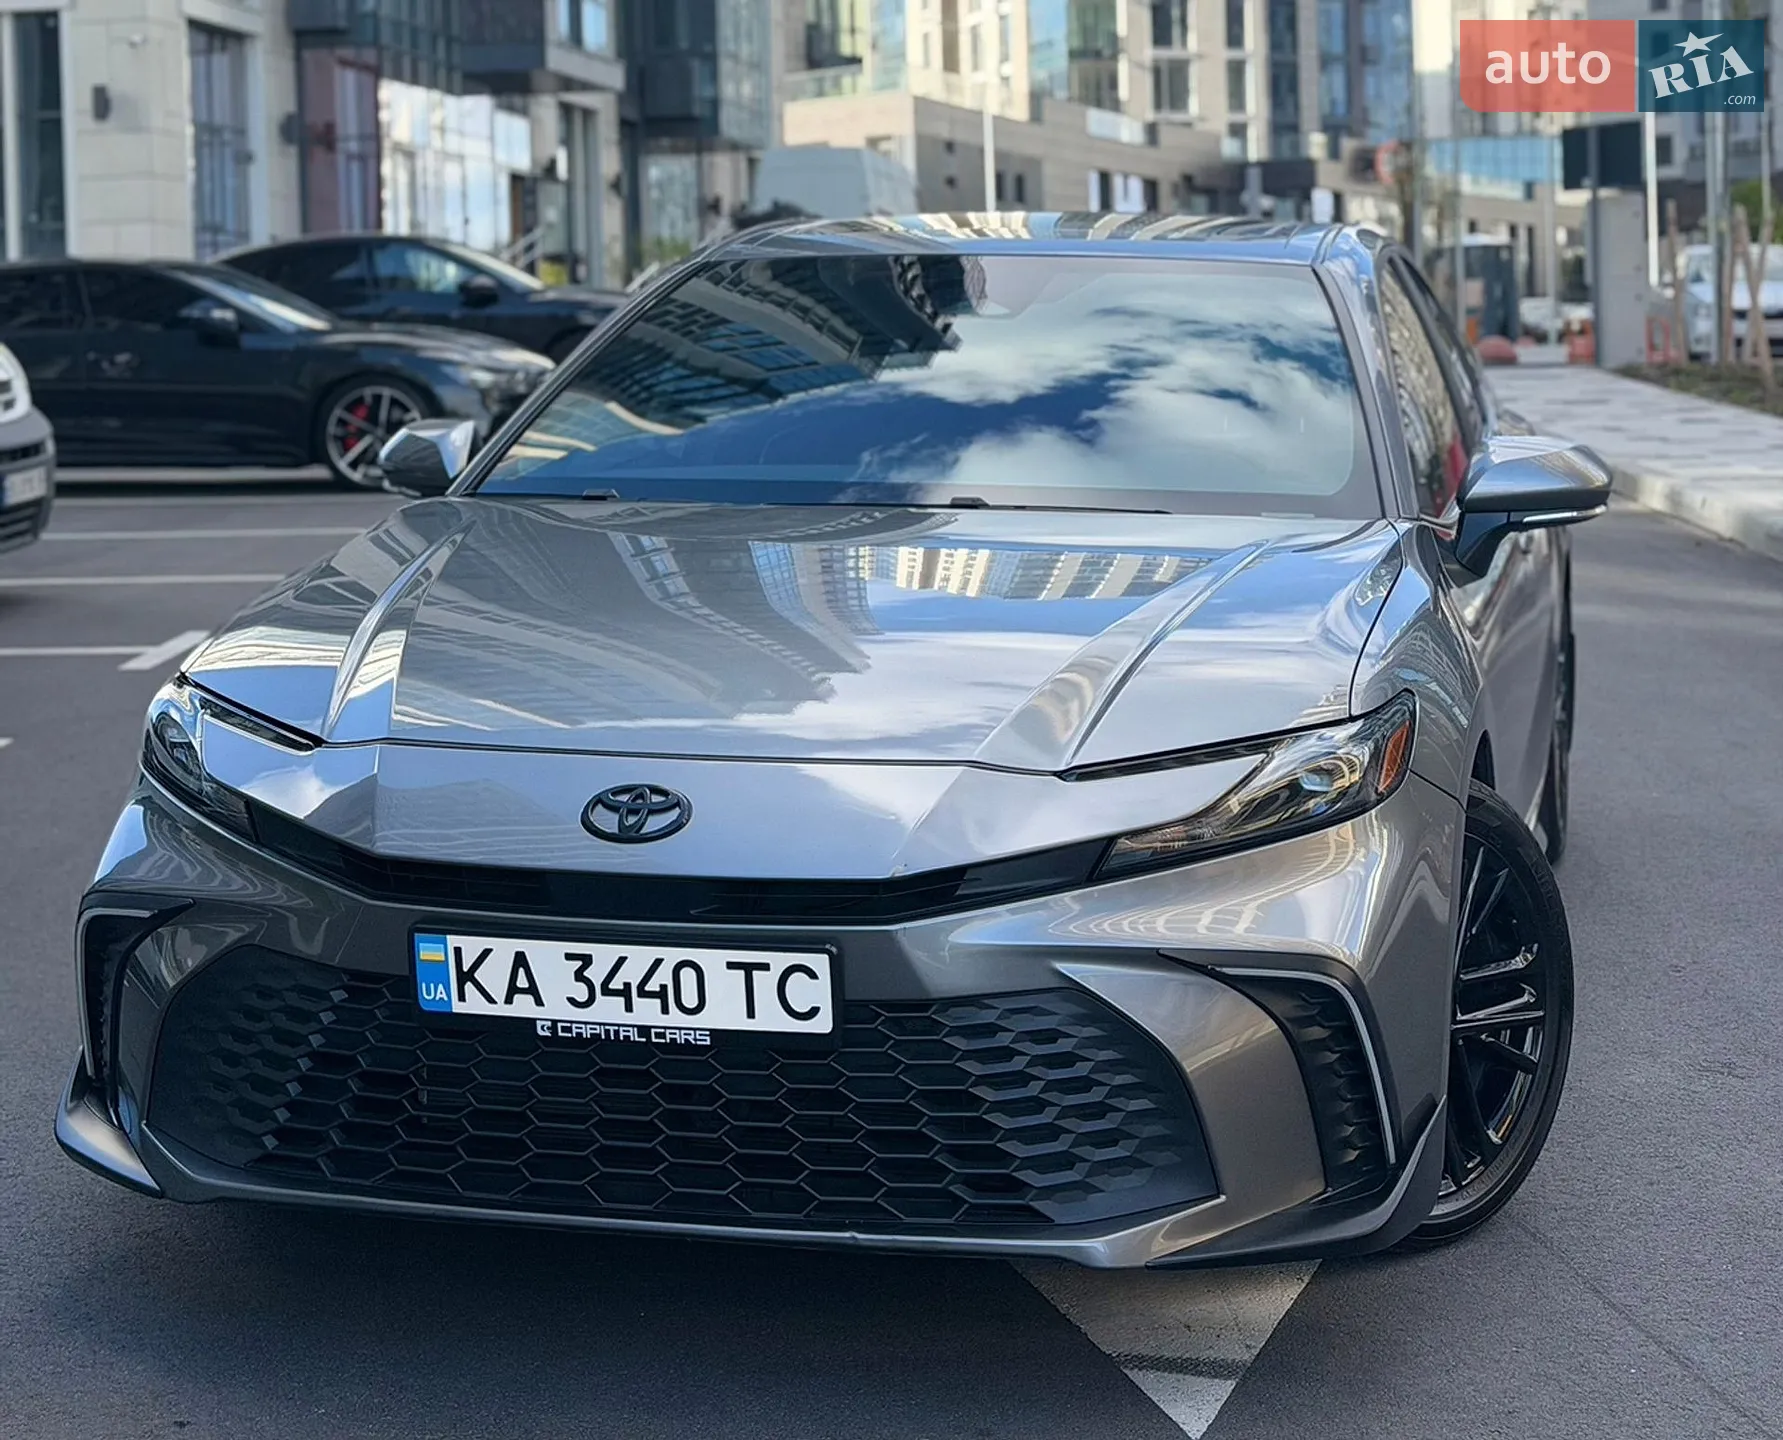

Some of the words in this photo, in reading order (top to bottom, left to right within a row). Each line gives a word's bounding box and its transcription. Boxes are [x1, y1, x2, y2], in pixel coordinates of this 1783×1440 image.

[422, 982, 448, 1001] UA
[453, 945, 545, 1008] KA
[564, 952, 707, 1016] 3440
[726, 961, 821, 1022] TC
[557, 1022, 646, 1043] CAPITAL
[651, 1028, 711, 1045] CARS
